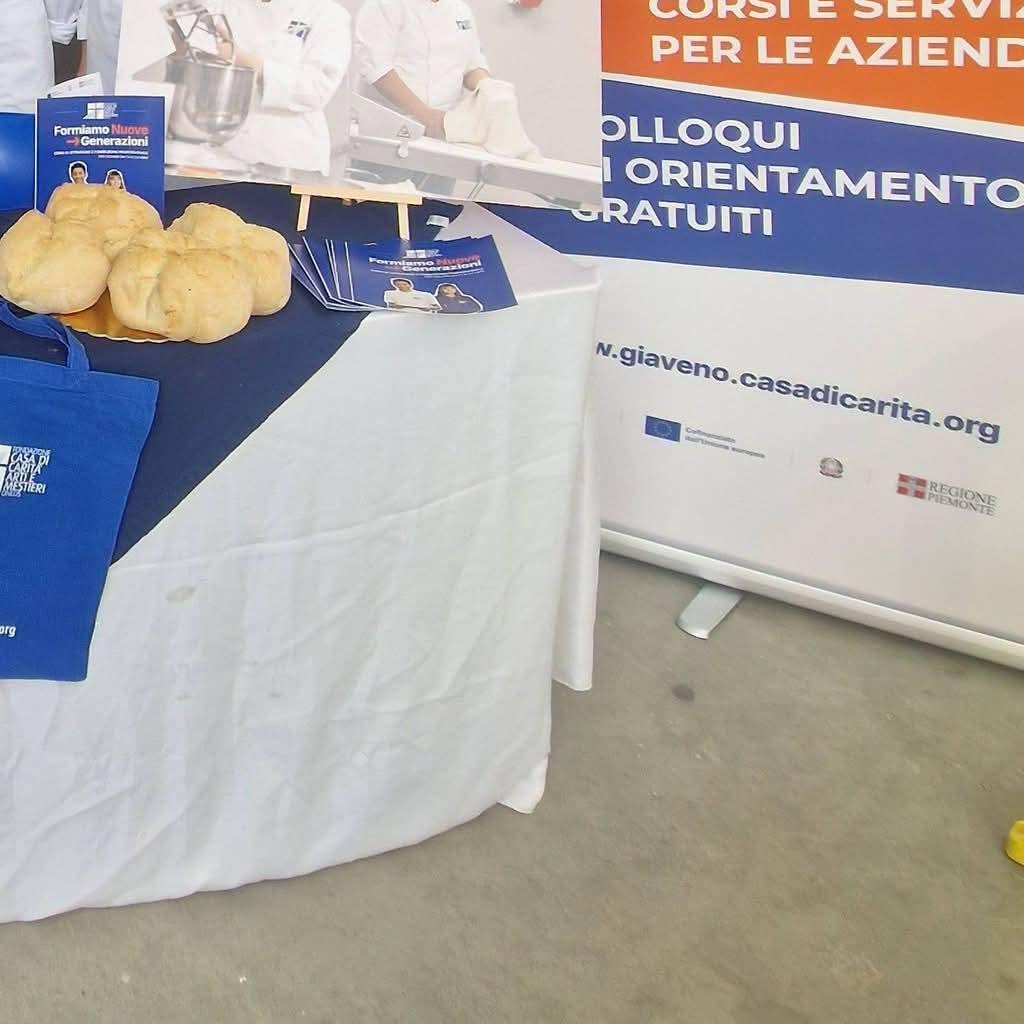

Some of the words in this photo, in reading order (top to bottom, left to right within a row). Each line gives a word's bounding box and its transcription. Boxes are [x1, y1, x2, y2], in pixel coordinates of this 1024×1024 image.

[651, 34, 741, 64] PER
[758, 36, 814, 65] LE
[827, 36, 1024, 69] AZIEND
[54, 124, 109, 137] Formiamo
[111, 123, 149, 136] Nuove
[80, 136, 149, 148] Generazioni
[602, 114, 800, 154] OLLOQUI
[603, 156, 612, 182] I
[625, 157, 1024, 210] ORIENTAMENTO
[596, 341, 1001, 445] w.giaveno.casadicarita.org
[11, 453, 36, 465] CASA
[39, 455, 50, 466] DI
[3, 481, 47, 494] MESTIERI
[6, 472, 28, 482] ARTI
[927, 492, 996, 516] PIEMONTE
[929, 481, 997, 506] REGIONE
